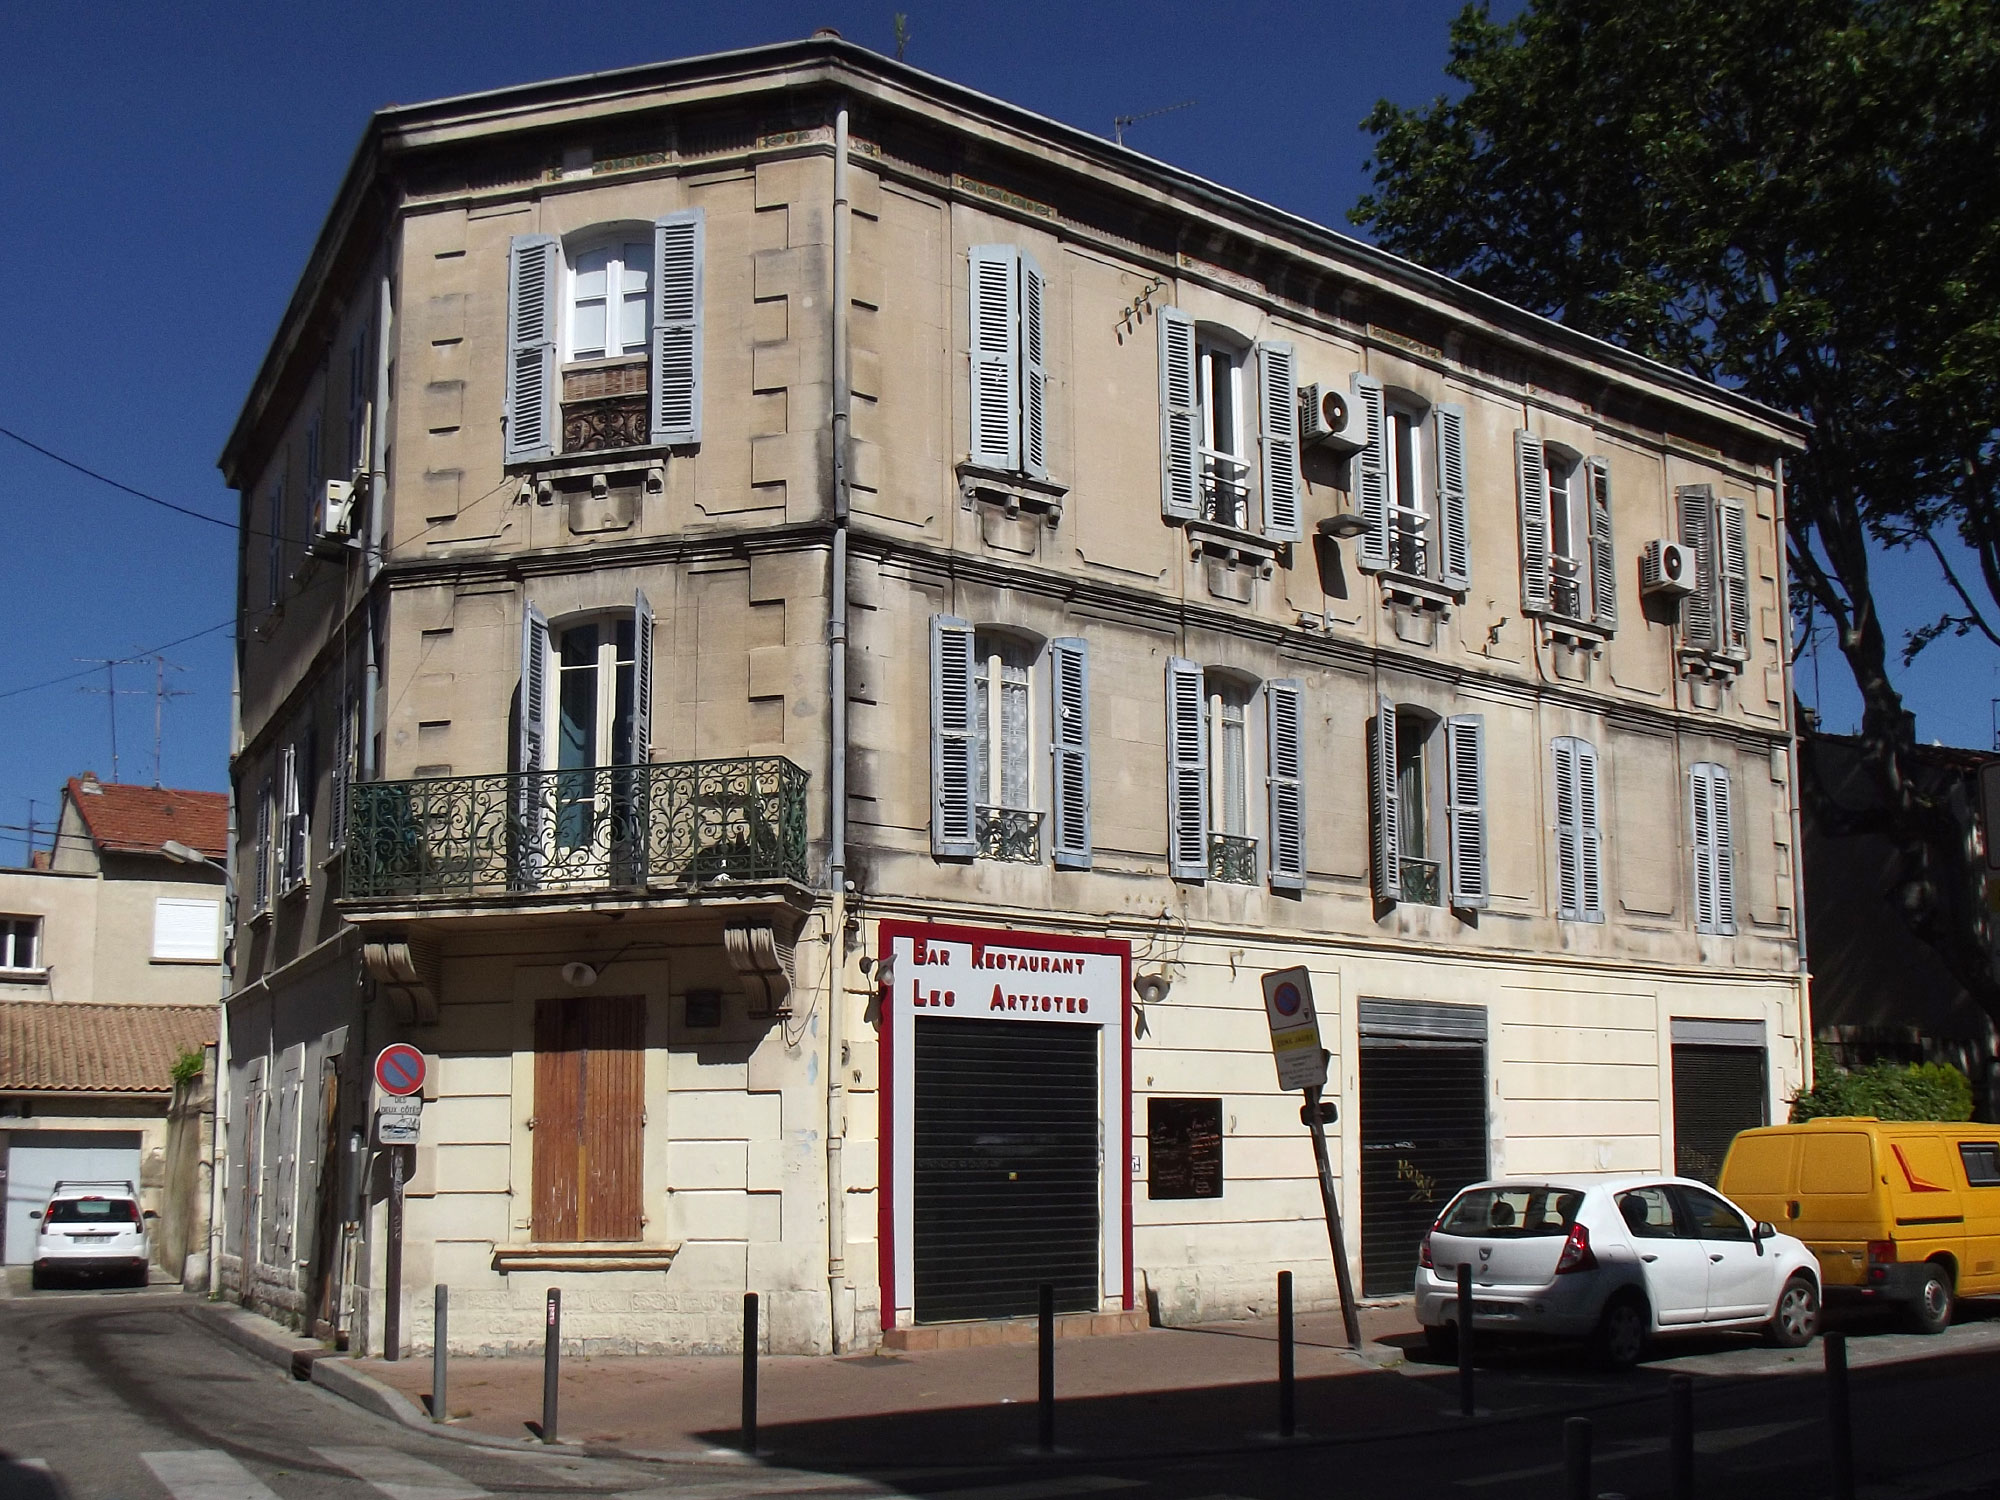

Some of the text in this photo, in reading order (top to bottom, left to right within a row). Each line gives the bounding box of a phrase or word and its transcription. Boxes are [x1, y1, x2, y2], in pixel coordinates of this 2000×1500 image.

[913, 937, 1085, 974] BAR RESTAURANT
[913, 979, 1089, 1014] LES ARTISTES
